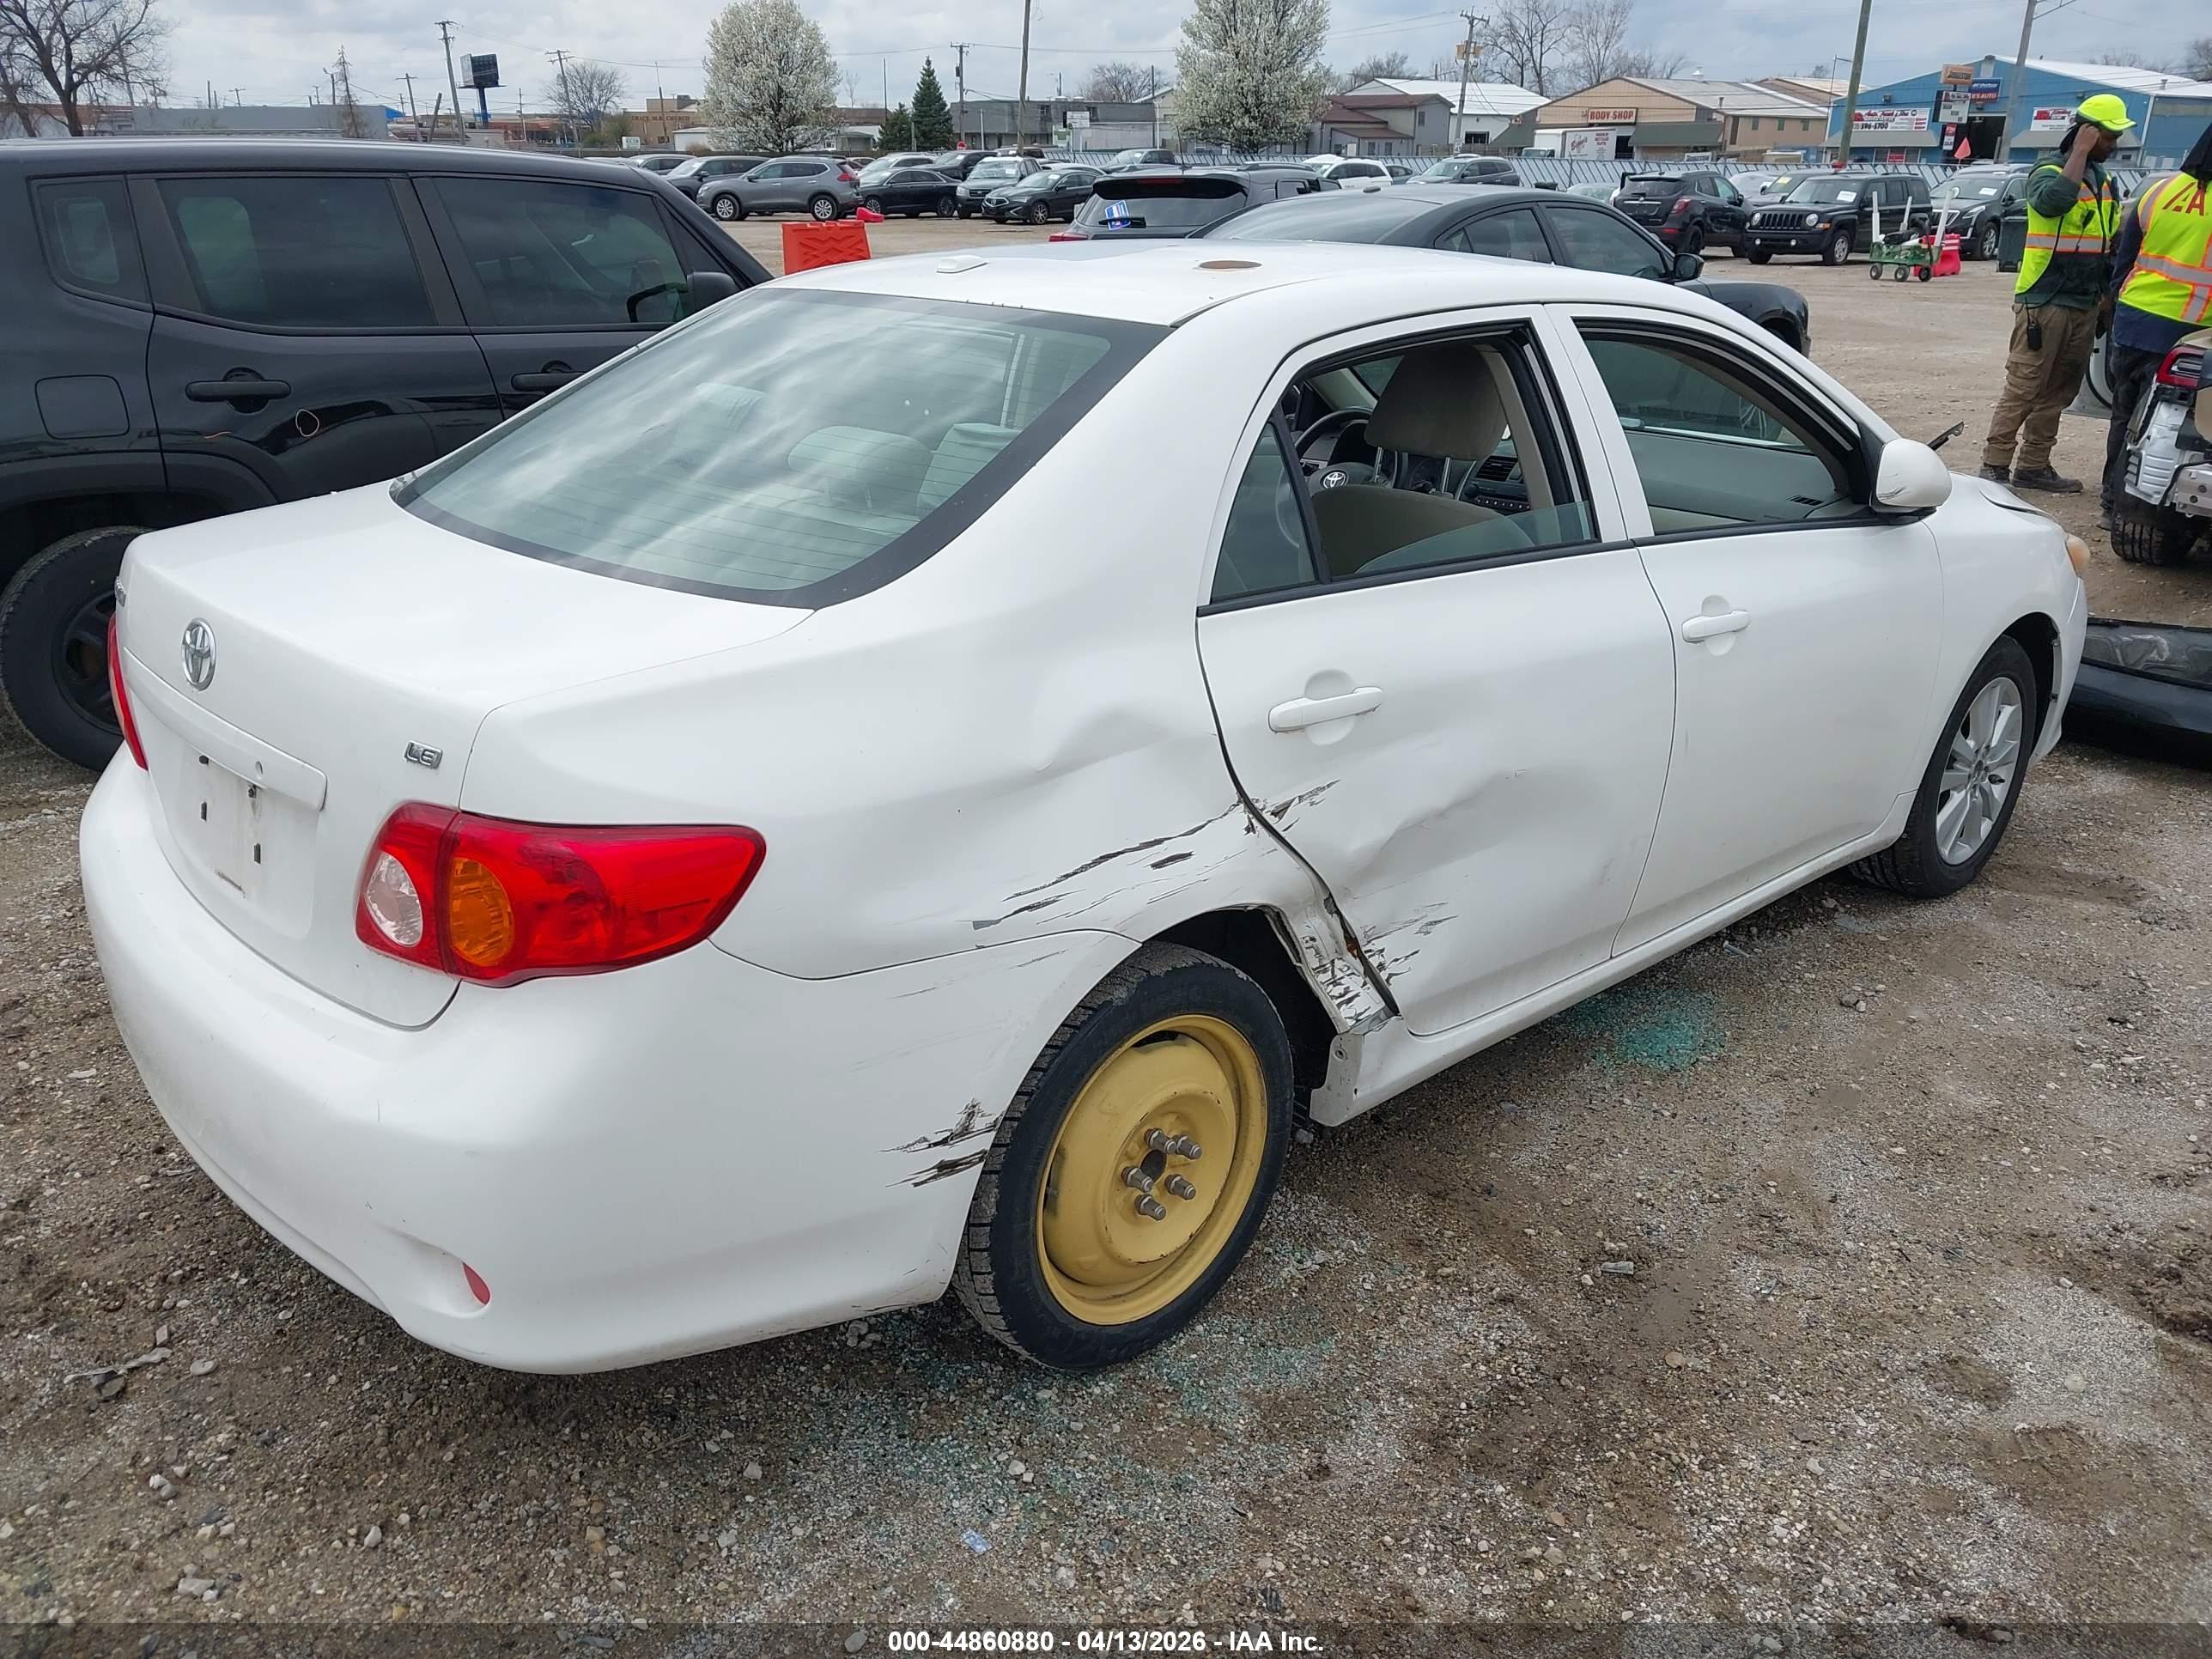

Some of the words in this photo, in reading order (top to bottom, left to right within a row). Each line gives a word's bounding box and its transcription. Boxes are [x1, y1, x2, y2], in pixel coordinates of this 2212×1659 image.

[1589, 110, 1611, 120] BODY
[1612, 109, 1634, 120] SHOP
[405, 741, 441, 769] LE
